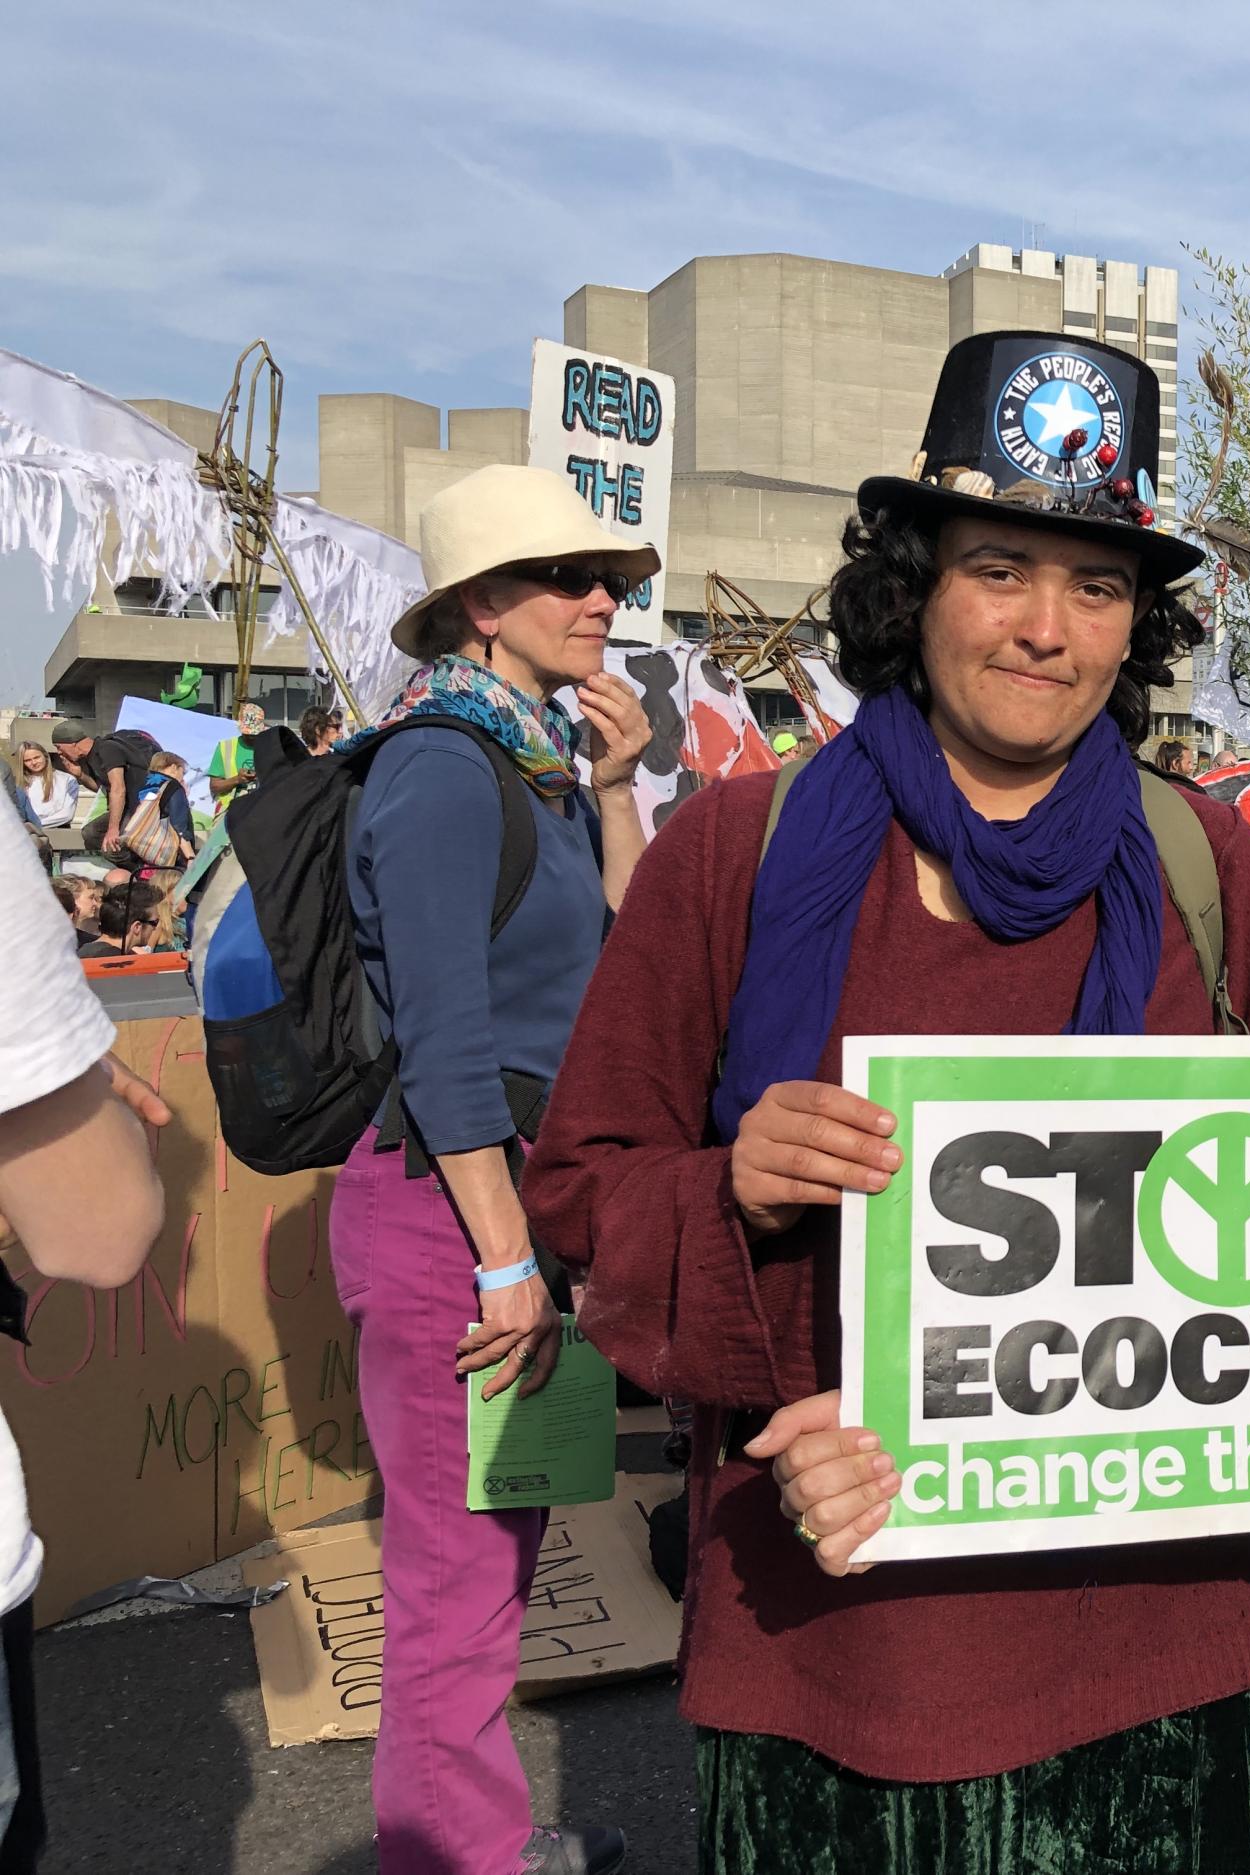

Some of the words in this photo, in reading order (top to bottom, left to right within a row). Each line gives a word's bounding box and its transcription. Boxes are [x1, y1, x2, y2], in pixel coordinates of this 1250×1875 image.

[562, 358, 662, 446] READ
[1004, 367, 1040, 401] THE
[1039, 356, 1116, 406] PEOPLE'S
[1000, 426, 1049, 476] EARTH
[1081, 411, 1122, 480] REPIC
[567, 454, 645, 526] THE
[15, 1212, 202, 1387] OIN
[136, 1354, 291, 1480] MORE
[230, 1411, 379, 1535] HERE
[902, 1440, 1187, 1514] change
